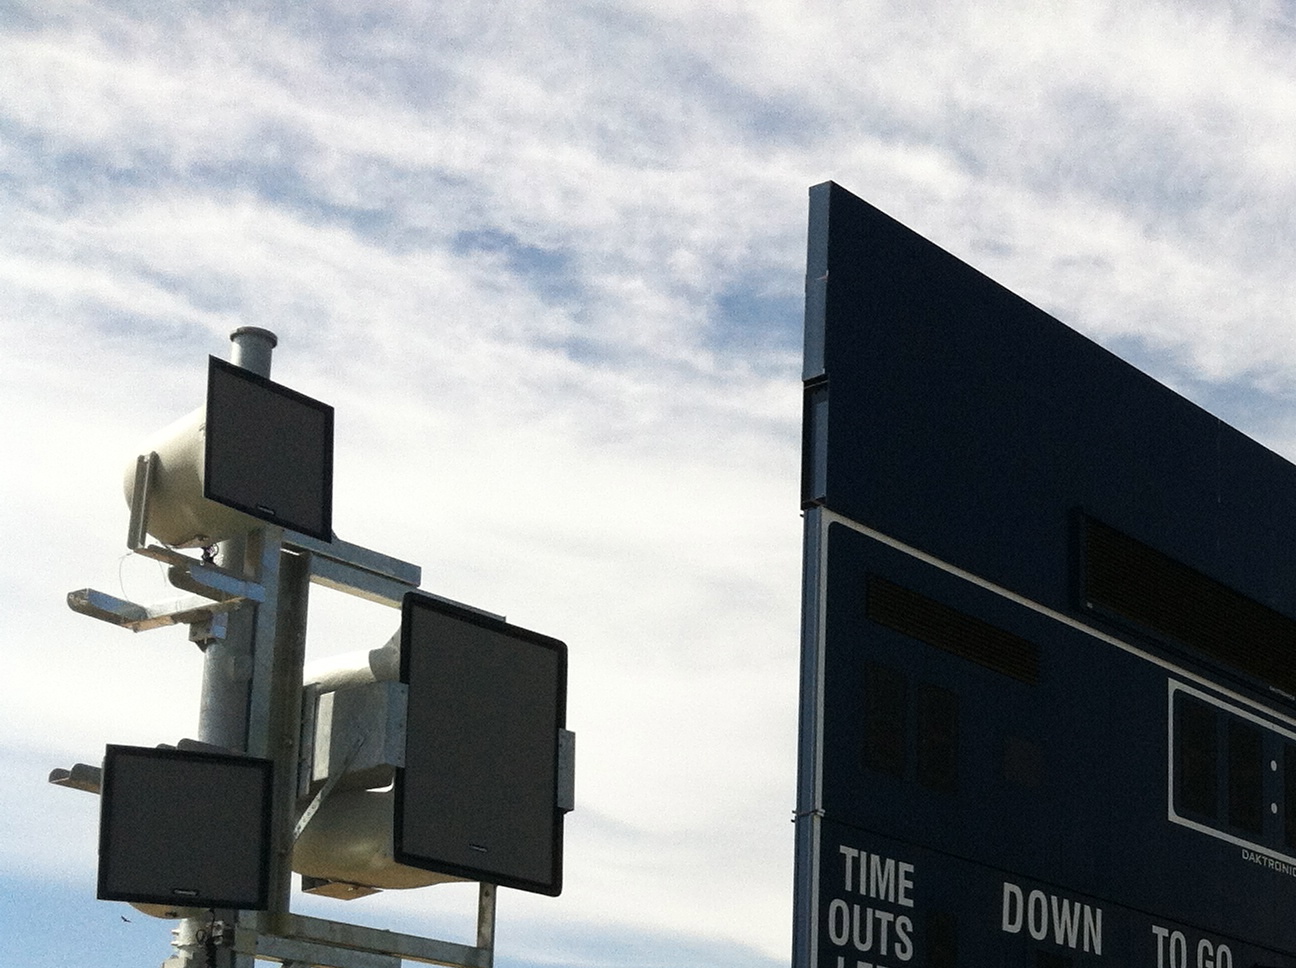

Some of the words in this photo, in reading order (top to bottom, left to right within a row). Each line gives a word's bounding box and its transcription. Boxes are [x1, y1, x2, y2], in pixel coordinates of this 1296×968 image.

[839, 844, 915, 908] TIME
[828, 898, 914, 961] OUTS
[1001, 881, 1103, 956] DOWN
